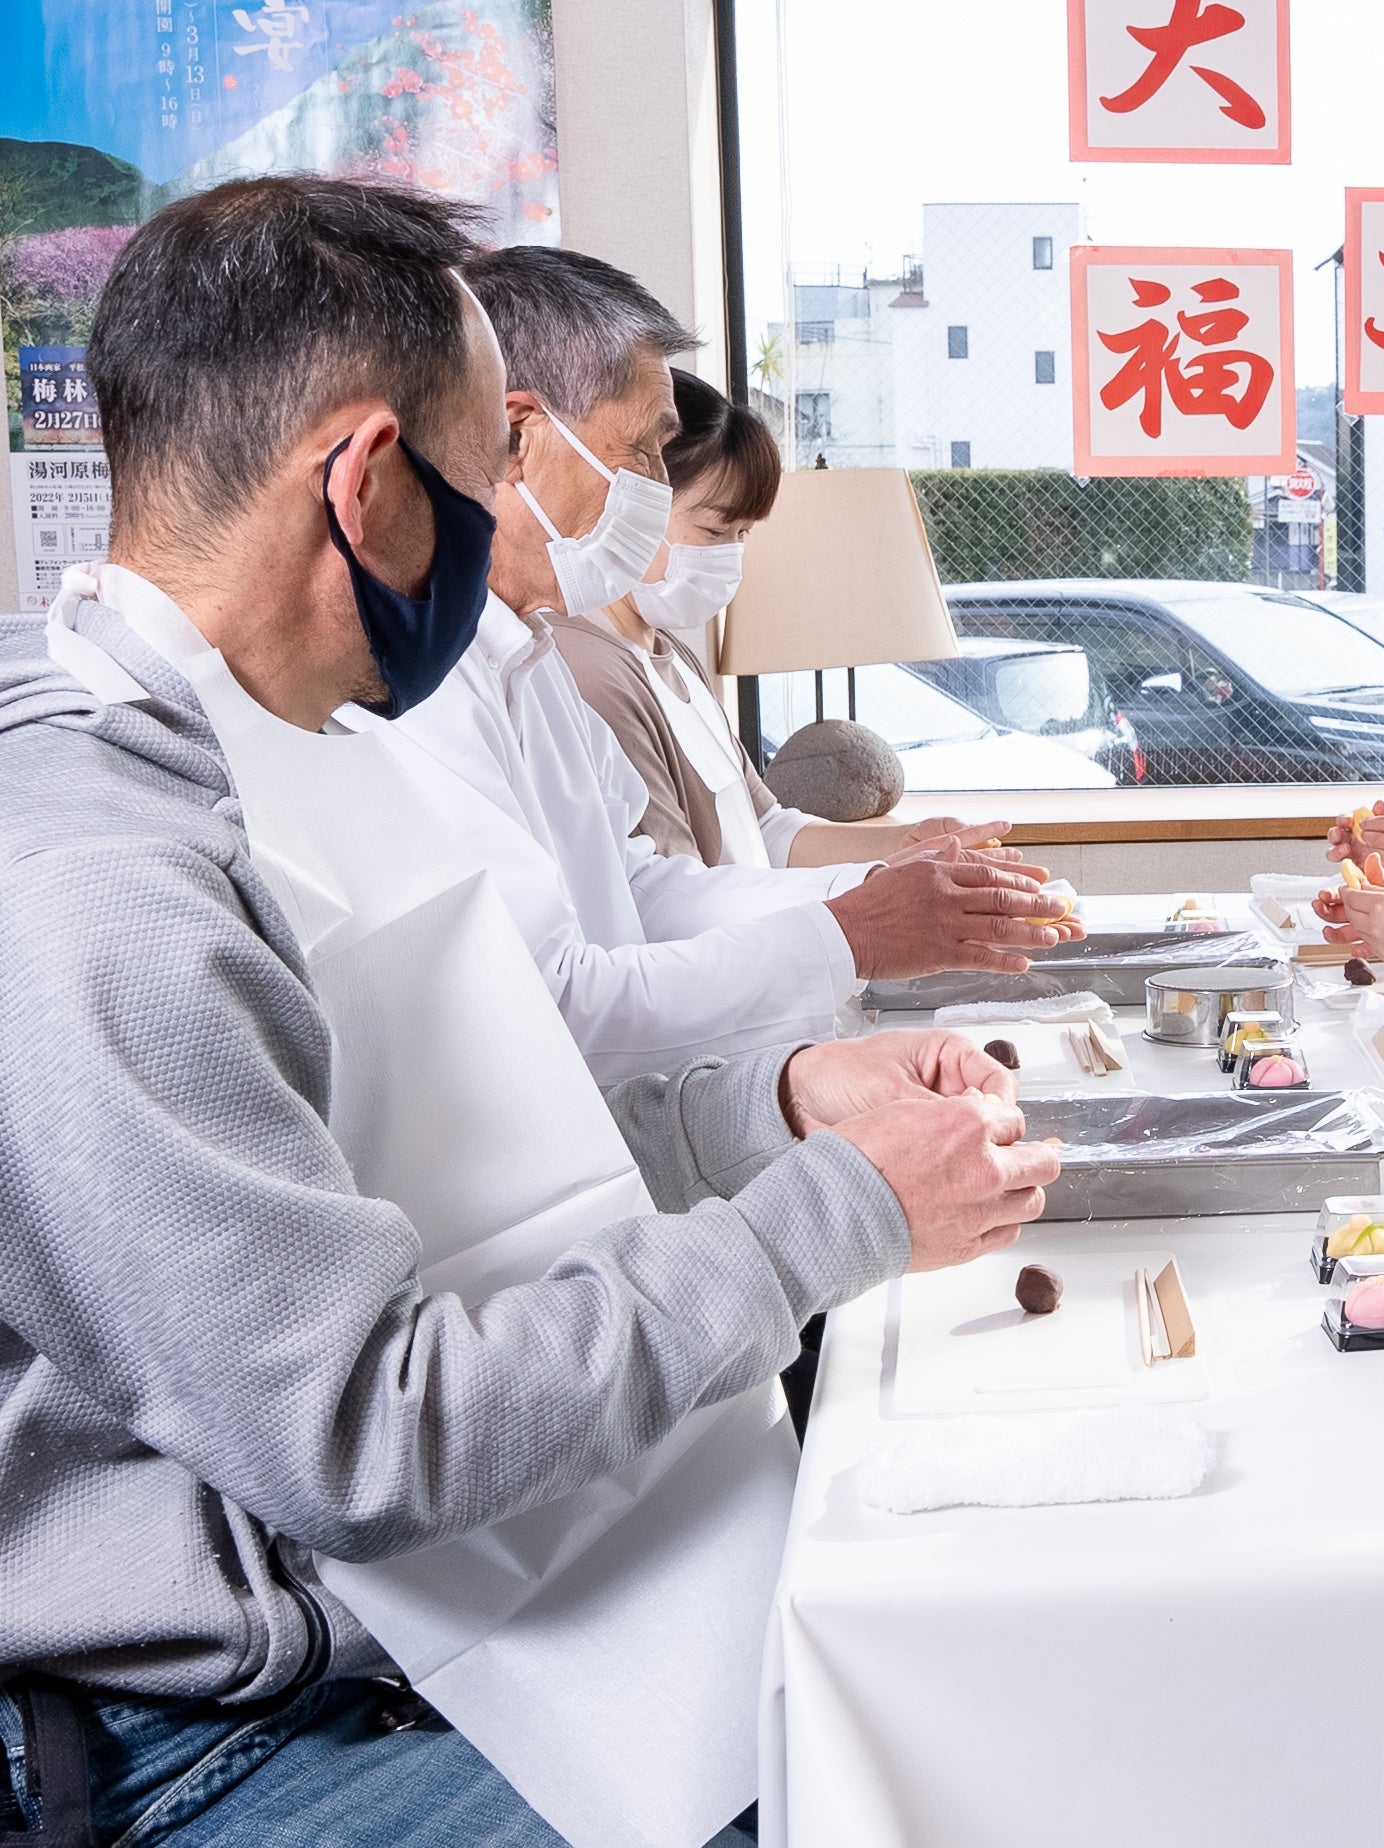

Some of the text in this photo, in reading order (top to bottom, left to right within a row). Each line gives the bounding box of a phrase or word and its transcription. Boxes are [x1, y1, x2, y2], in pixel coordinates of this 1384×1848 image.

[1099, 0, 1266, 129] 大
[32, 378, 98, 403] 梅林
[1097, 277, 1275, 439] 福
[29, 461, 110, 479] 湯河原梅
